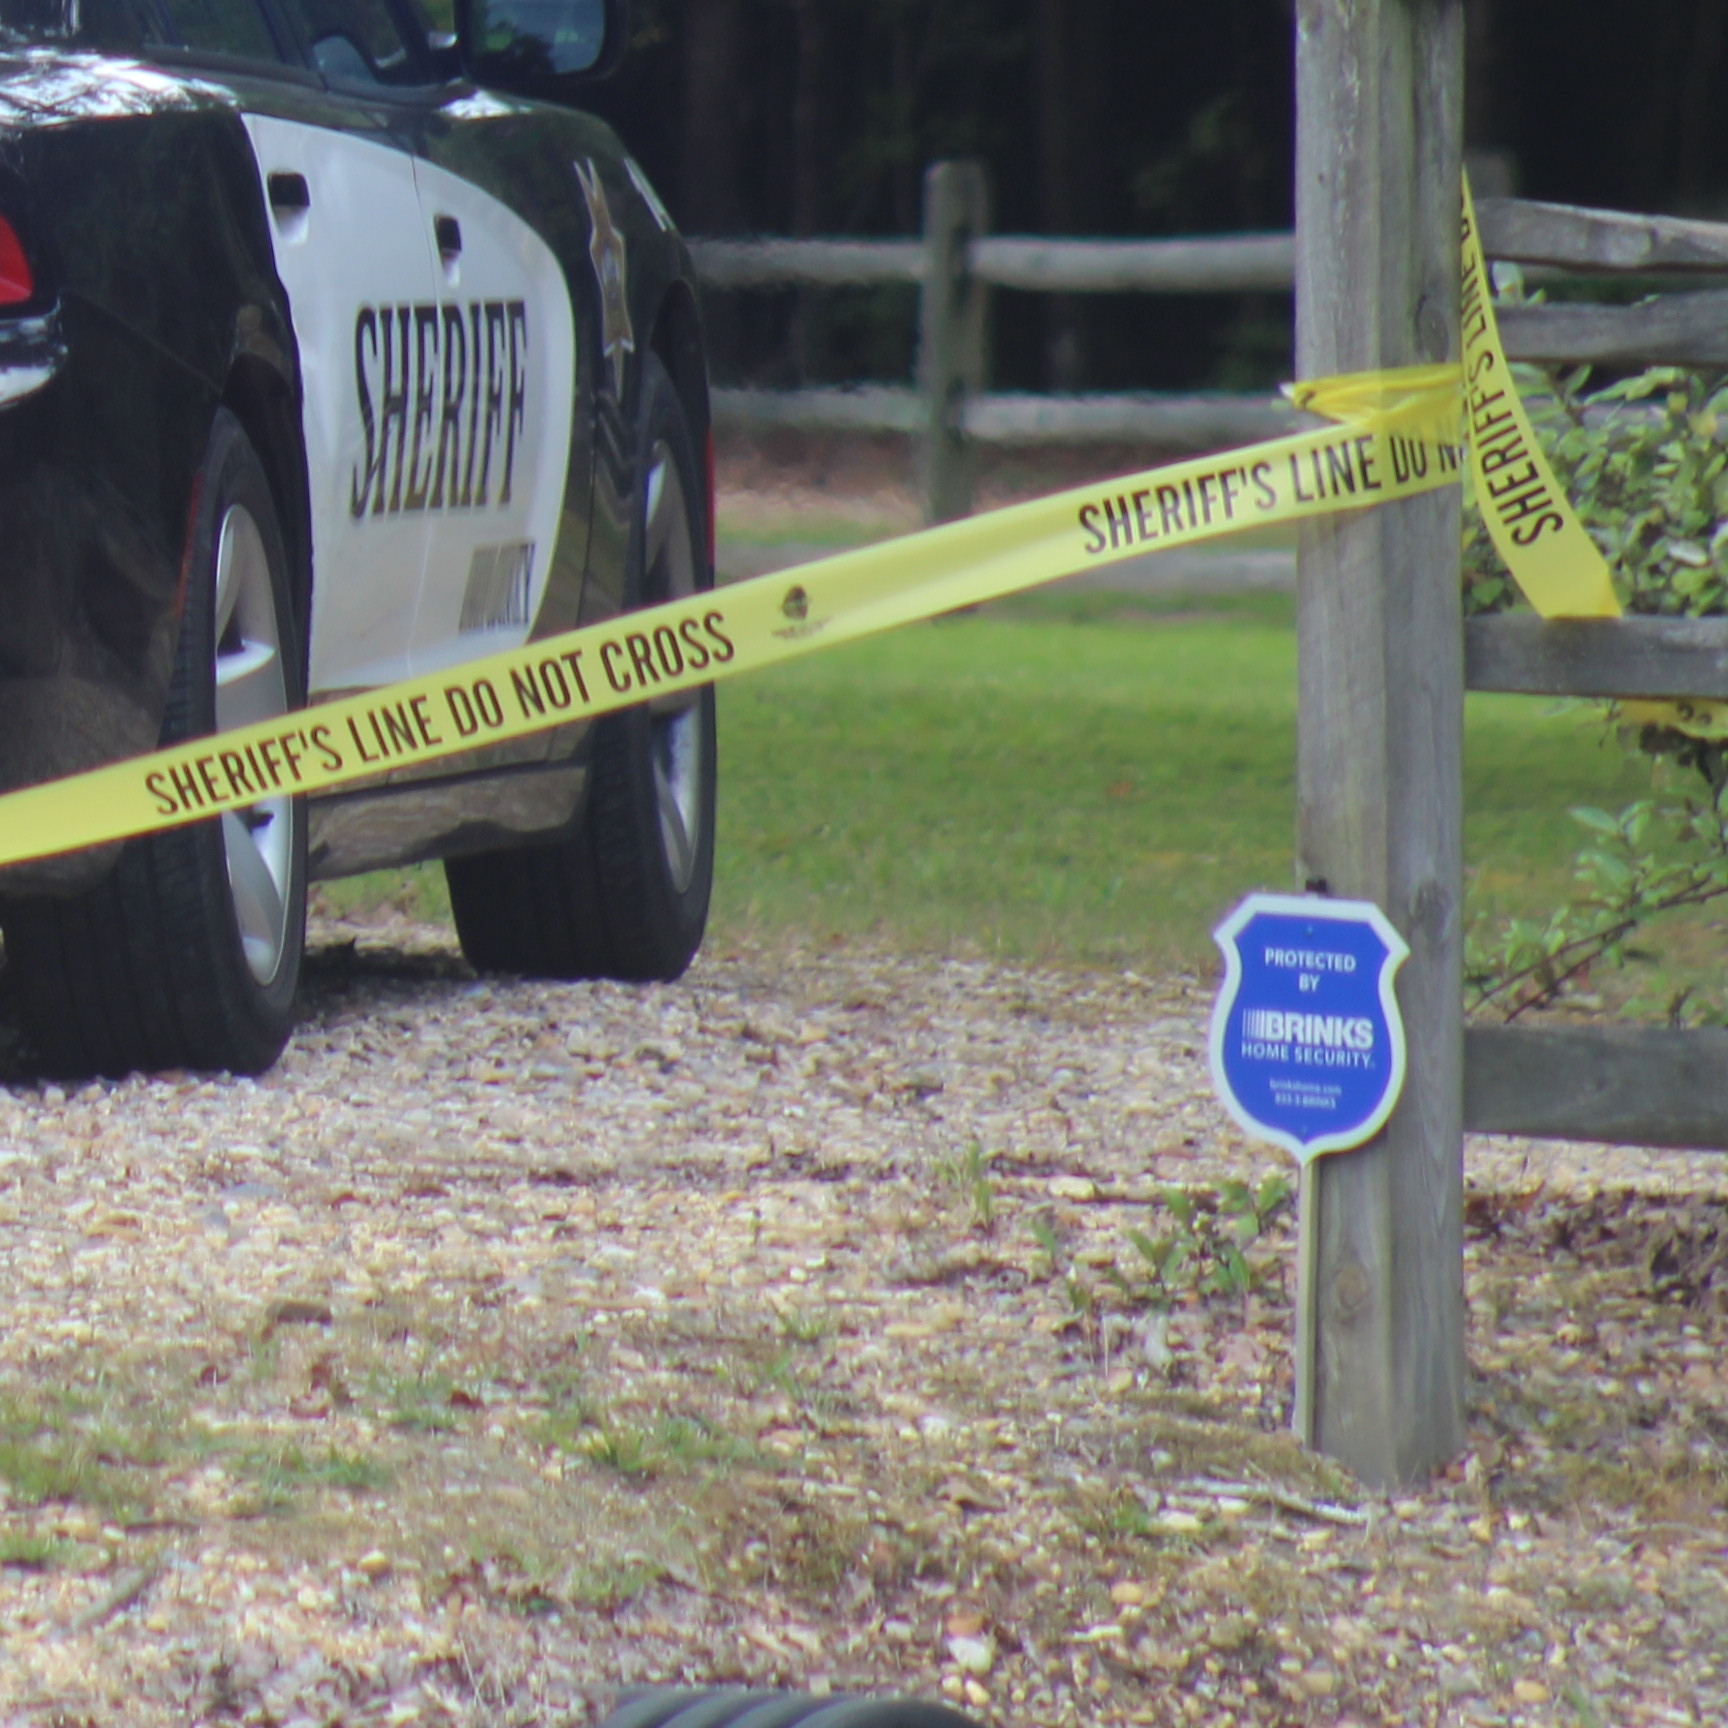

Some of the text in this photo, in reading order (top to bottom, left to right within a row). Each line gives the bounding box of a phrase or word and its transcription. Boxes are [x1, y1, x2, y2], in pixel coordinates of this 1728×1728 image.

[350, 299, 528, 525] SHERIFF
[1078, 460, 1277, 554] SHERIFF'S
[1289, 434, 1383, 503] LINE
[145, 609, 735, 816] SHERIFF'S LINE DO NOT CROSS
[1264, 947, 1358, 973] PROTECTED
[1298, 973, 1321, 992] BY
[1264, 1009, 1374, 1051] BRINKS
[1242, 1041, 1373, 1070] HOME SECURITY
